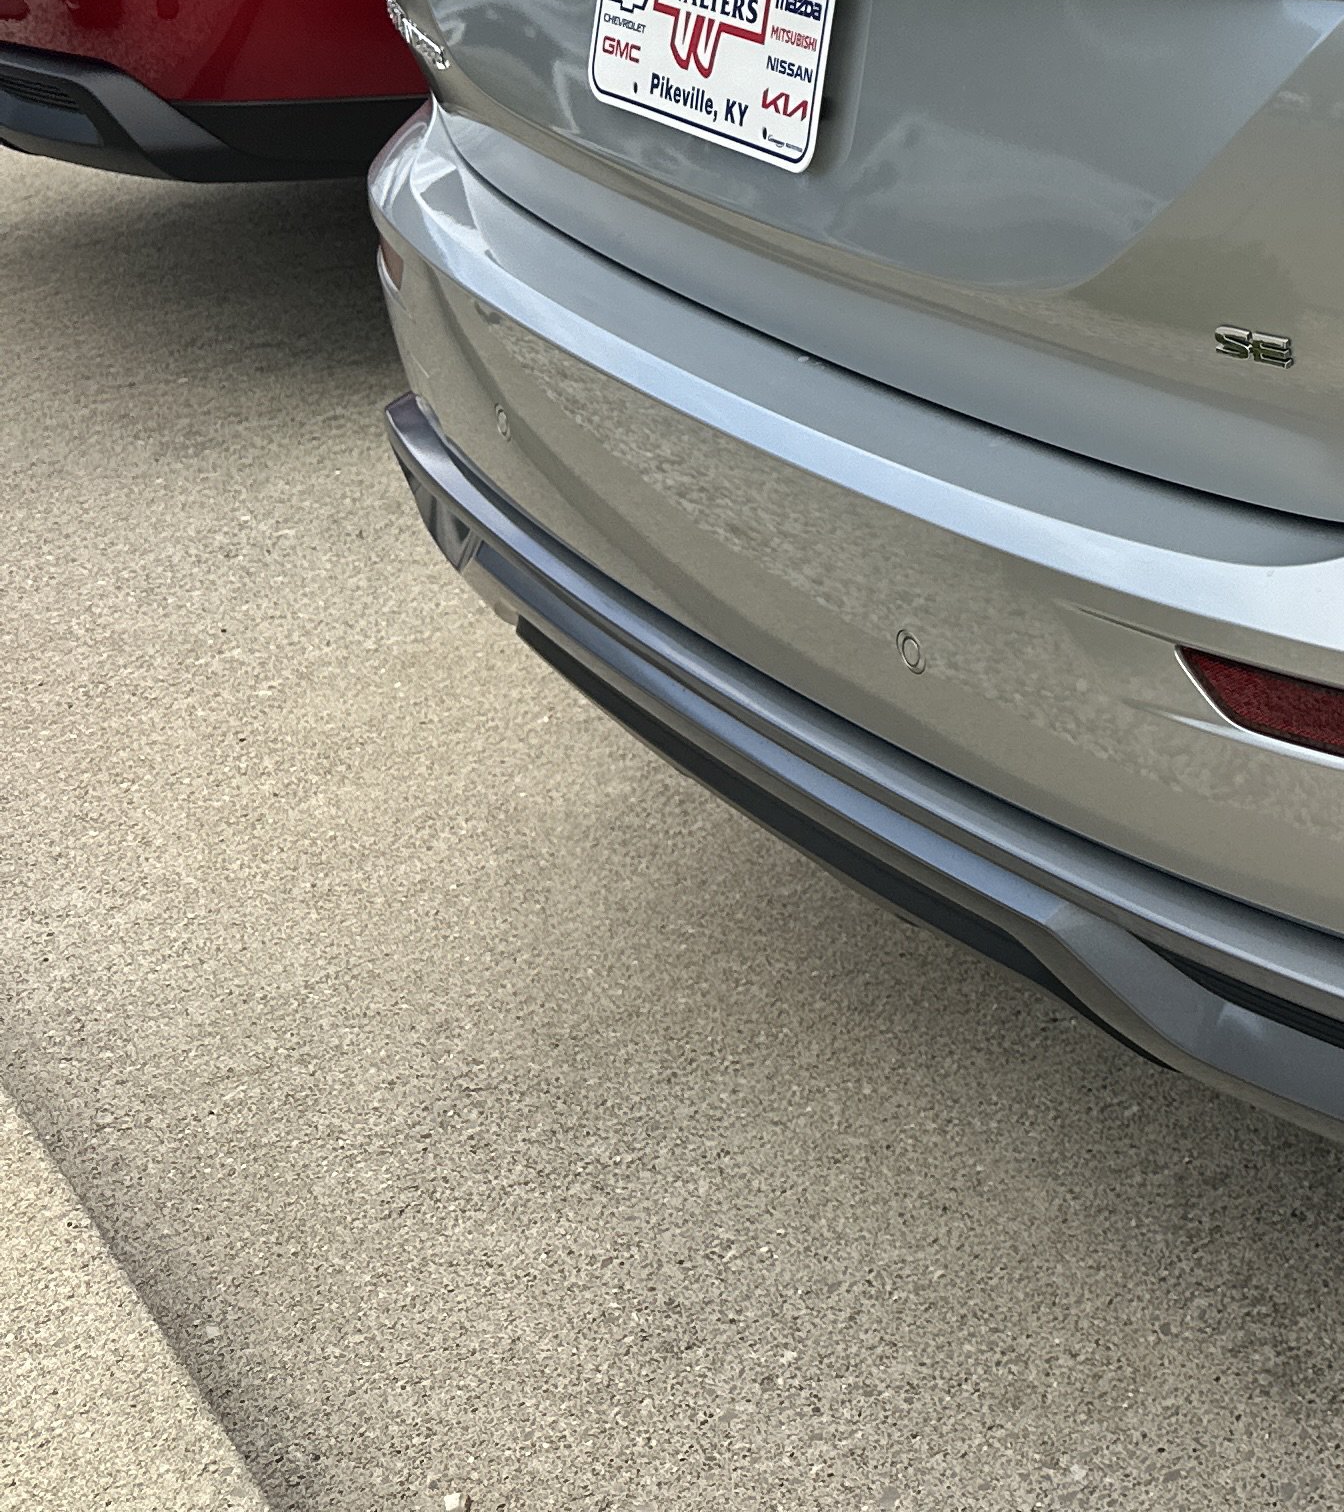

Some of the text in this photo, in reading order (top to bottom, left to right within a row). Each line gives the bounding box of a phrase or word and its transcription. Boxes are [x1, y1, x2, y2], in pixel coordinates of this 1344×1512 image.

[603, 12, 647, 35] CHEVROLET
[602, 35, 642, 64] GMC
[770, 25, 818, 53] MITSUBISHI
[766, 55, 814, 84] NISSAN
[650, 72, 749, 127] Pikeville, KY
[1214, 324, 1294, 369] SE
